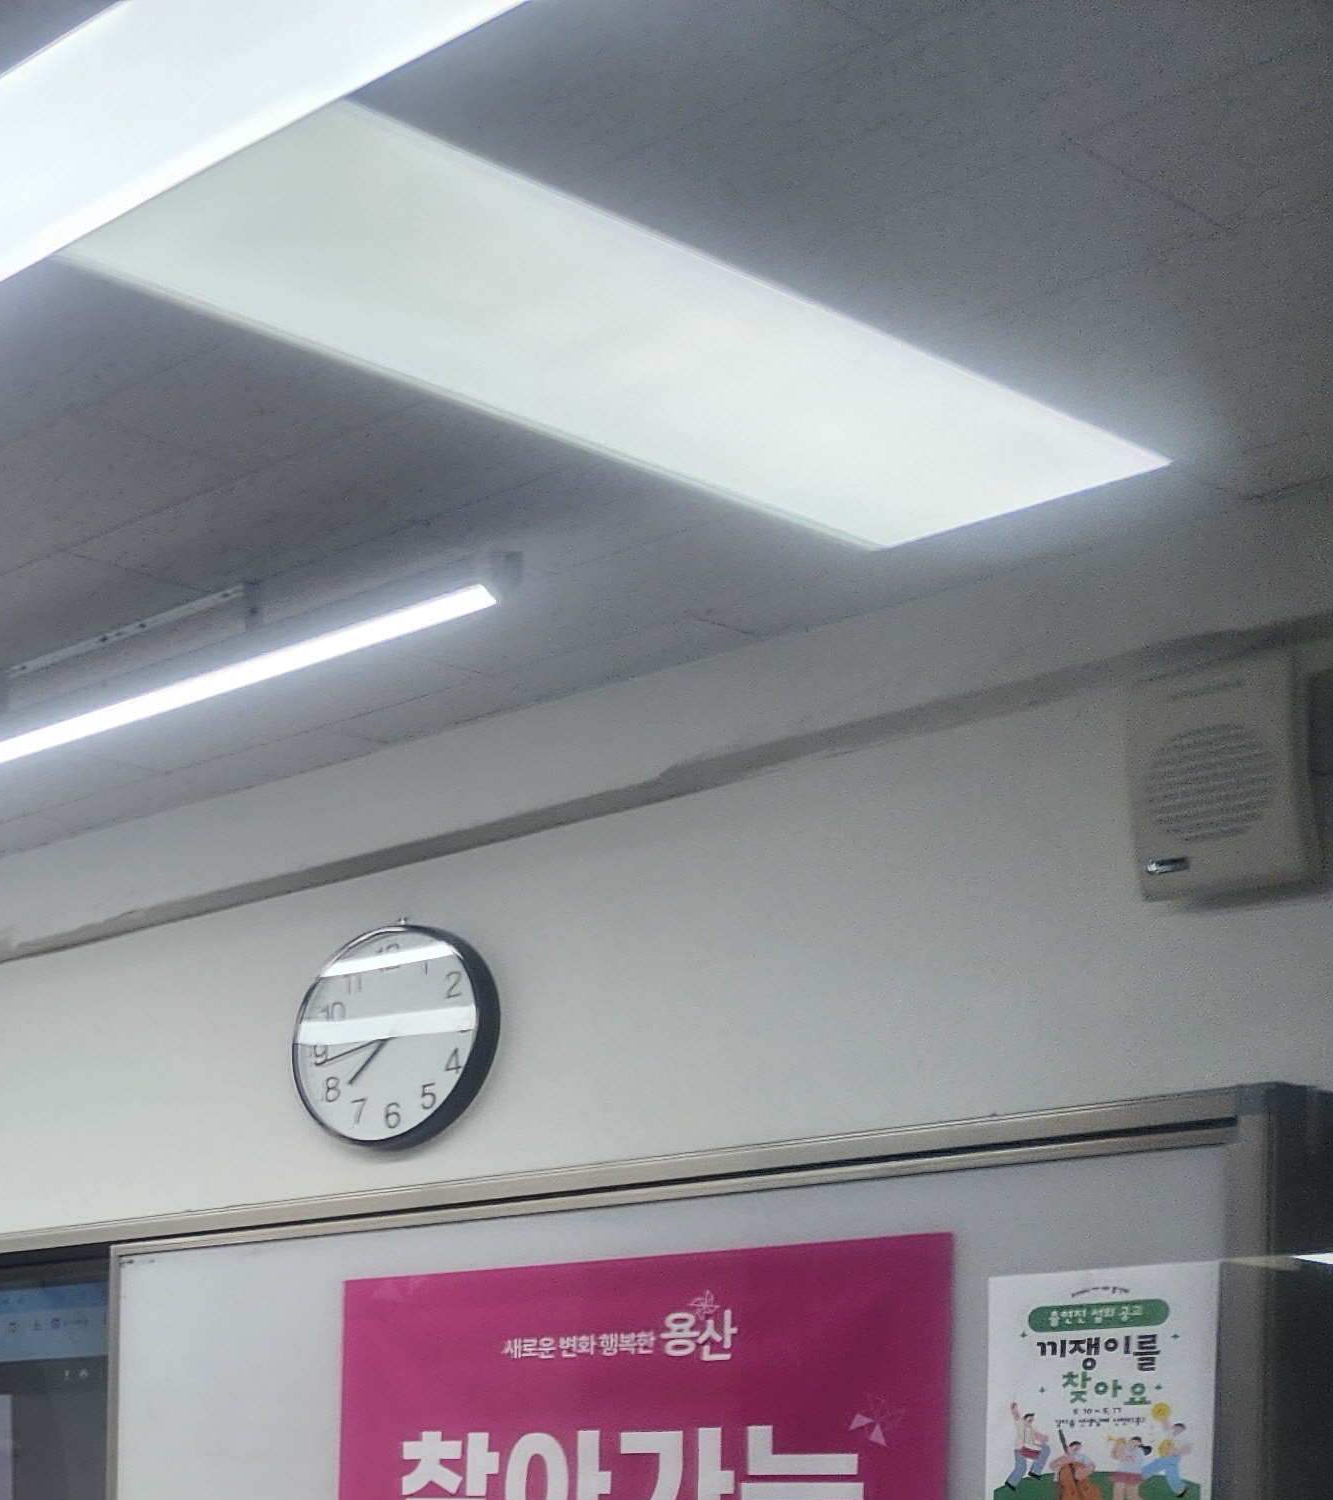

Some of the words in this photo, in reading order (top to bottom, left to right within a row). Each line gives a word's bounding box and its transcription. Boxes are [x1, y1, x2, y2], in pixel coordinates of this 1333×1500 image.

[445, 971, 462, 999] 2
[444, 1047, 462, 1074] 4
[324, 1076, 340, 1102] 8
[421, 1082, 436, 1110] 5
[350, 1098, 367, 1124] 7
[385, 1102, 401, 1129] 6
[502, 1338, 556, 1359] 새로운
[559, 1334, 598, 1358] 변화
[599, 1331, 656, 1356] 행복한
[660, 1308, 738, 1362] 용산
[1036, 1334, 1161, 1372] 끼쟁이를
[1062, 1371, 1152, 1405] 찾아요
